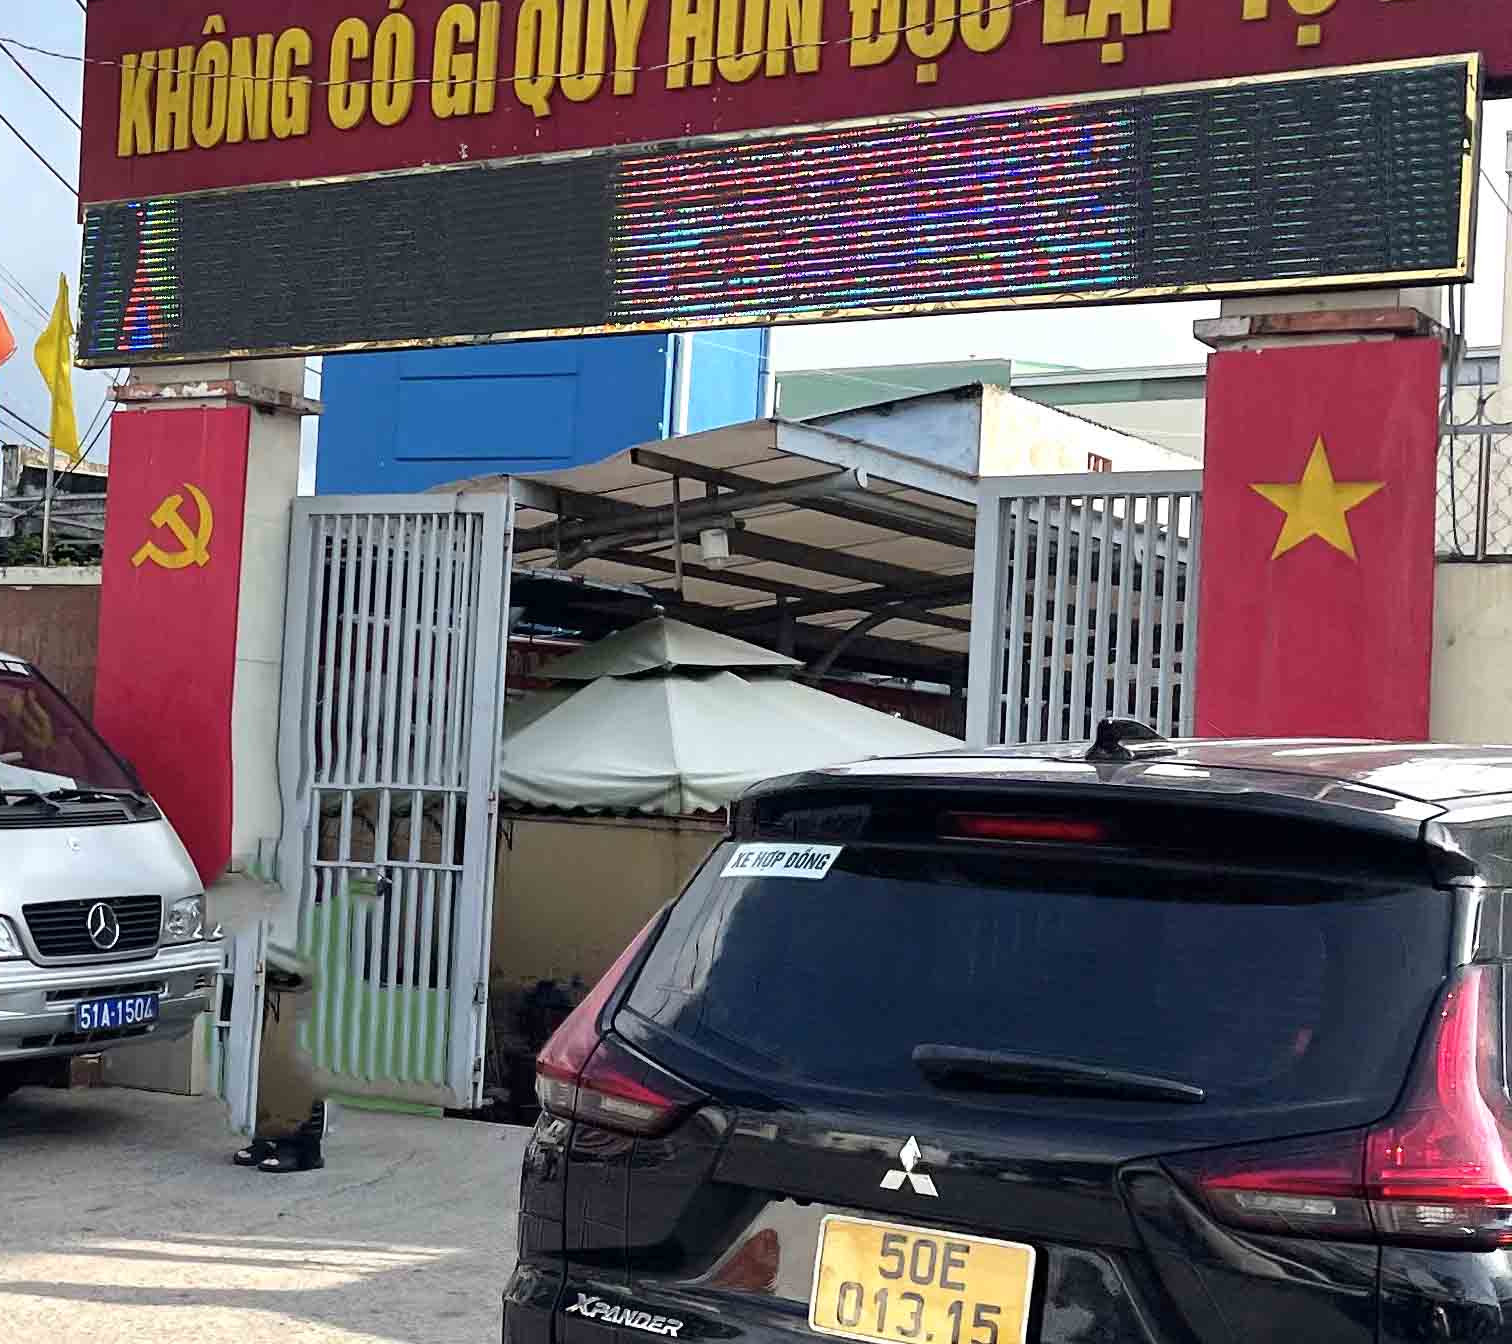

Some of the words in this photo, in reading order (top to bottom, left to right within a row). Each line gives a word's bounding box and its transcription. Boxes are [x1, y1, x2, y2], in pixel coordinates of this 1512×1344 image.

[118, 13, 312, 157] KHÔNG
[730, 851, 754, 868] XE
[751, 849, 786, 872] HỢP
[784, 846, 831, 871] ĐỒNG
[878, 1230, 971, 1291] 50E
[565, 1292, 684, 1338] XPANDER
